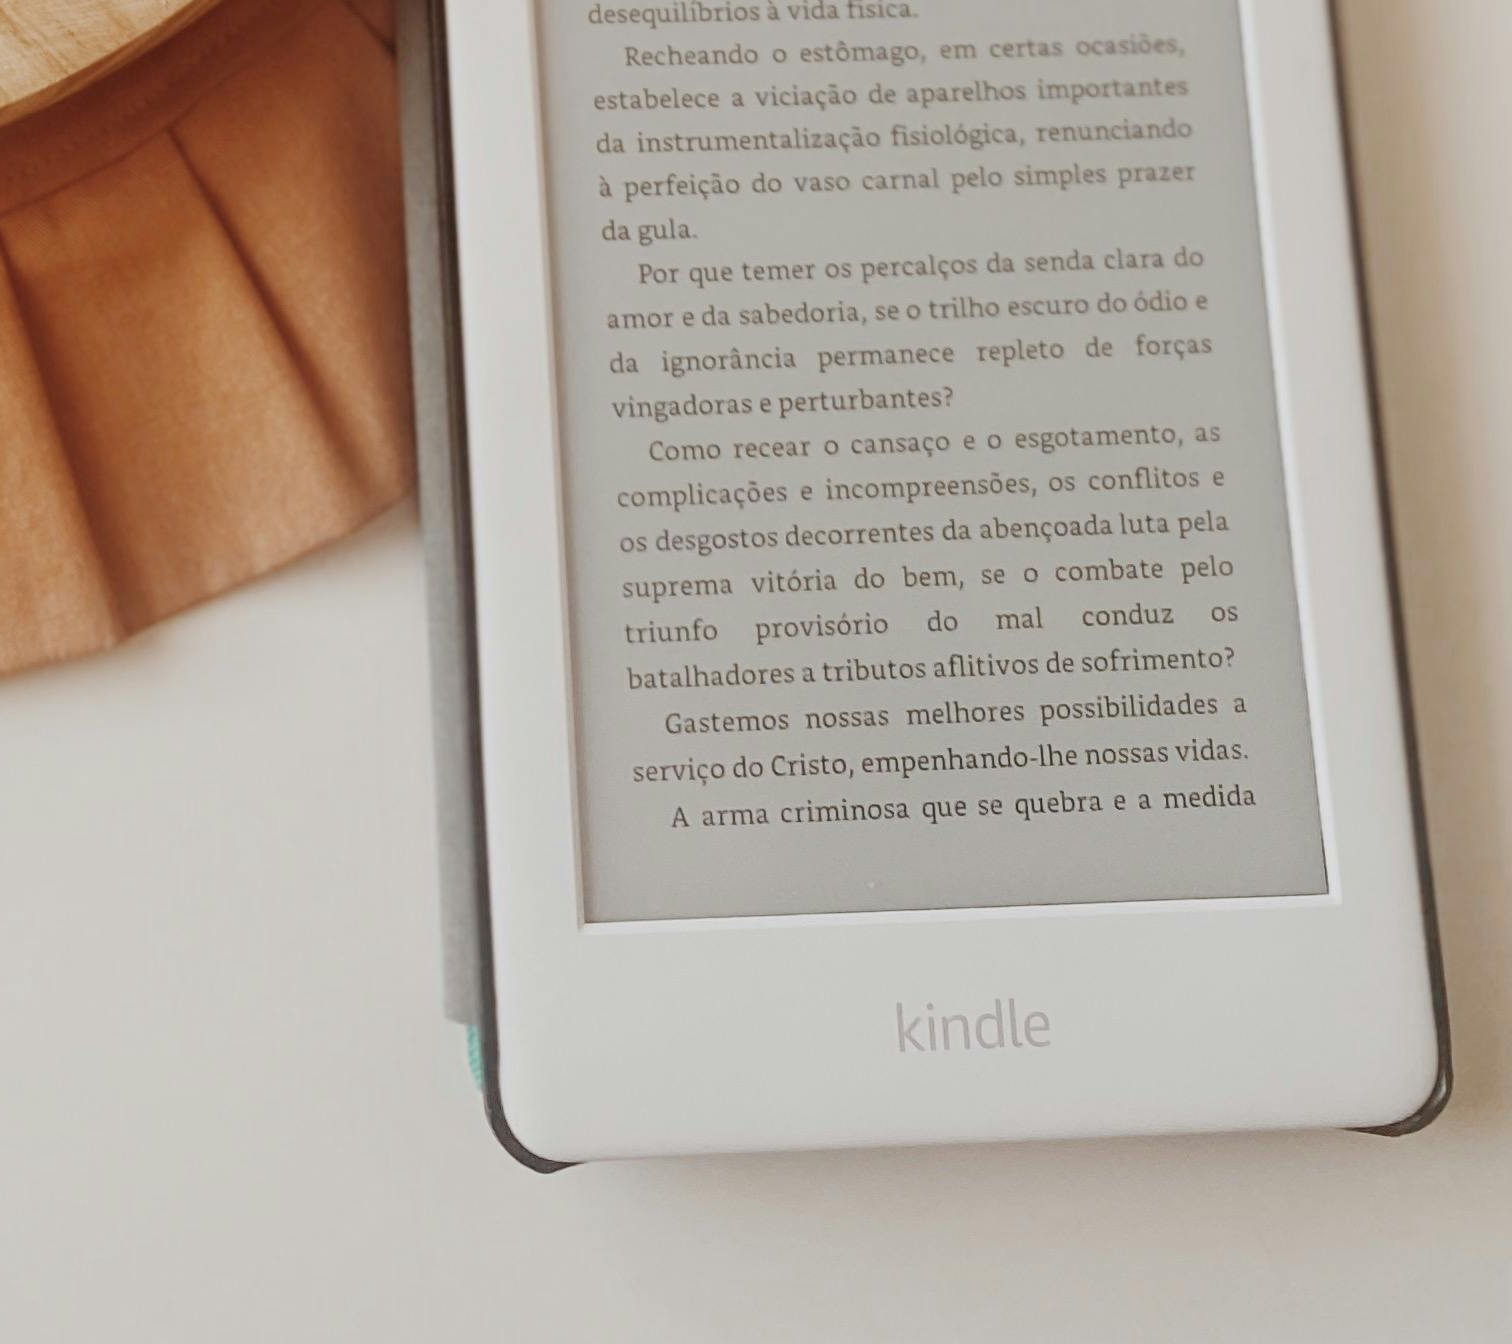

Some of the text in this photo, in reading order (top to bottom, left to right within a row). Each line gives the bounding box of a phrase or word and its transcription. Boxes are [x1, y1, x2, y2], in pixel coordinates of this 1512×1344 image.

[587, 0, 761, 31] desequilíbrios
[766, 0, 782, 22] à
[623, 42, 759, 67] Recheando
[771, 48, 788, 64] o
[799, 39, 927, 68] estômago,
[939, 43, 978, 60] em
[988, 39, 1064, 59] certas
[593, 77, 1190, 112] estabelece a viciação de aparelhos importantes
[595, 116, 1193, 155] da instrumentalização fisiológica, renunciando
[599, 162, 1196, 204] à perfeição do vaso carnal pelo simples prazer
[601, 217, 698, 247] da gula.
[637, 245, 1204, 290] Por que temer os percalços da senda clara do
[607, 289, 1208, 330] amor e da sabedoria, se o trilho escuro do ódio e
[609, 333, 1213, 379] da ignorância permanece repleto de forças
[611, 385, 954, 425] vingadoras e perturbantes?
[648, 425, 1221, 462] Como recear o cansaço e o esgotamento, as
[617, 465, 1225, 513] complicações e incompreensões, os conflitos e
[619, 509, 1230, 558] os desgostos decorrentes da abençoada luta pela
[622, 554, 1234, 605] suprema vitória do bem, se o combate pelo
[625, 602, 1239, 646] triunfo provisório do mal conduz os
[626, 646, 1235, 690] batalhadores a tributos aflitivos de sofrimento?
[665, 691, 1248, 735] Gastemos nossas melhores possibilidades a
[633, 737, 1249, 787] serviço do Cristo, empenhando-lhe nossas vidas.
[671, 783, 1257, 828] A arma criminosa que se quebra e a medida
[895, 997, 1051, 1053] kindle
